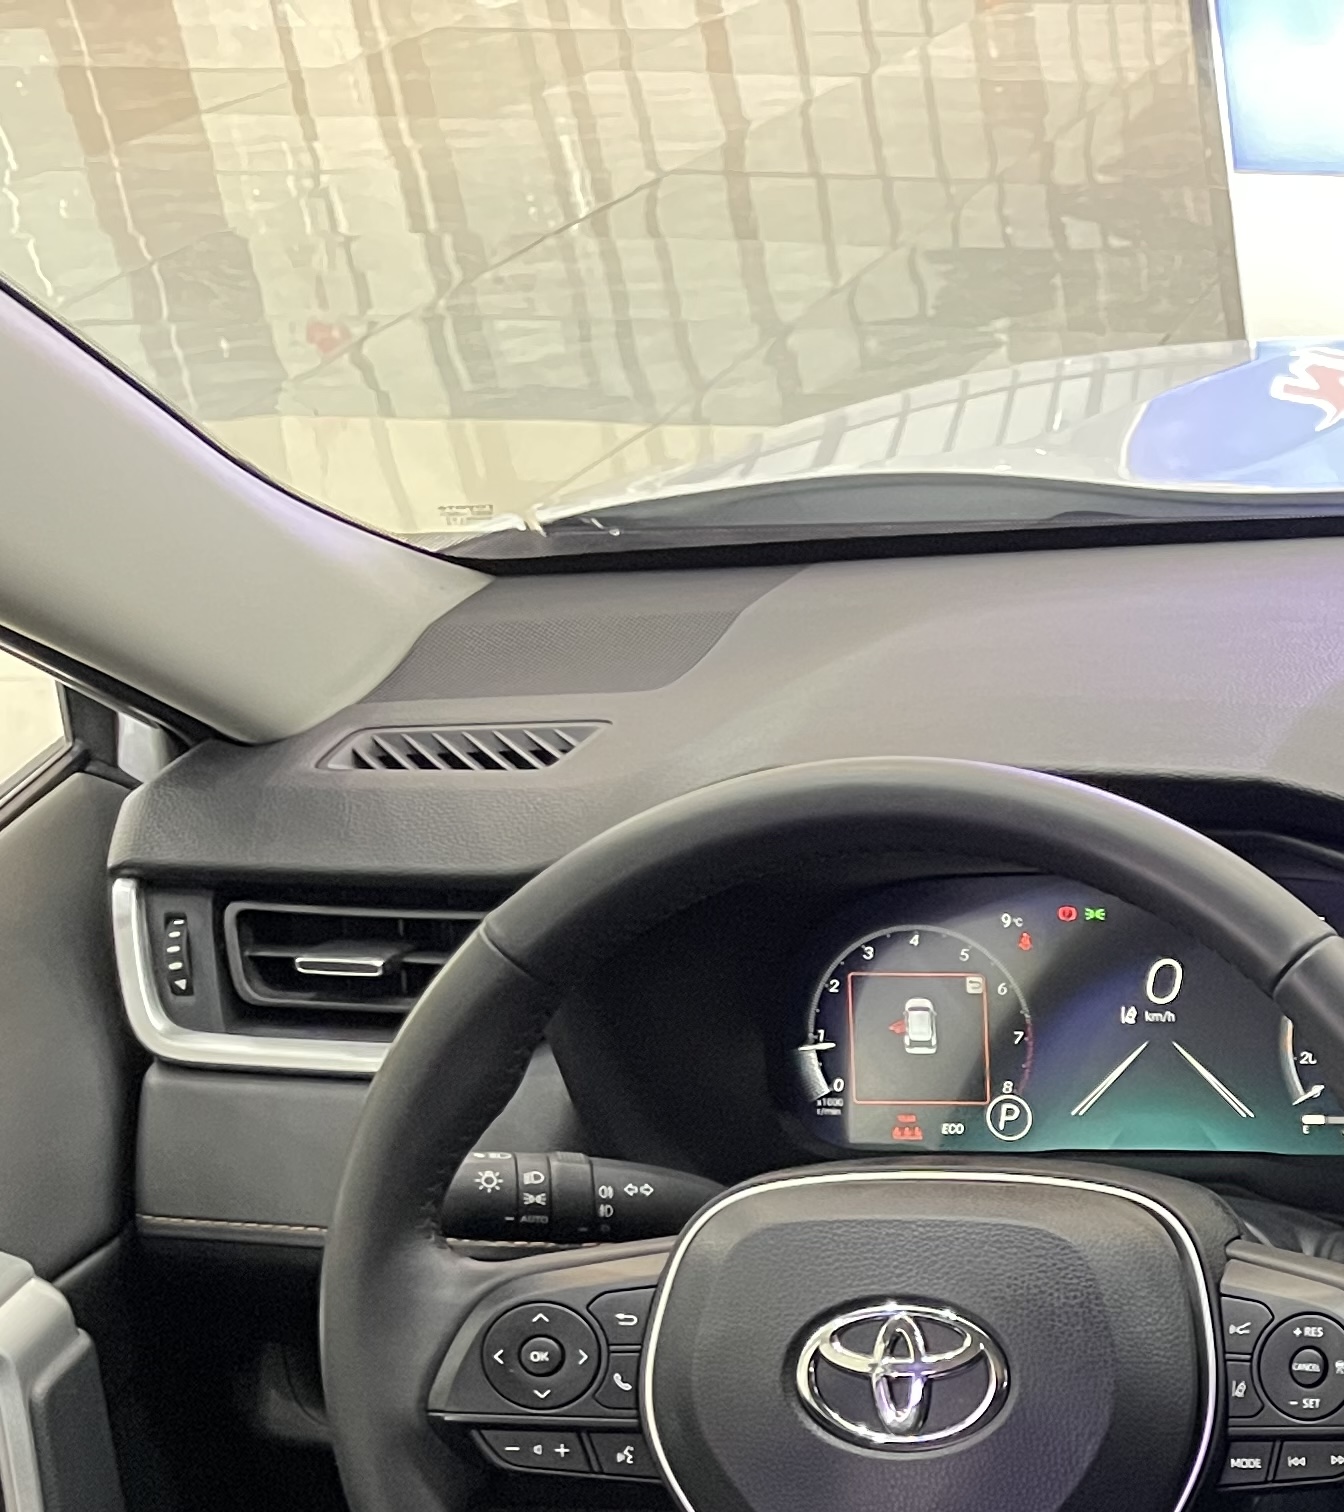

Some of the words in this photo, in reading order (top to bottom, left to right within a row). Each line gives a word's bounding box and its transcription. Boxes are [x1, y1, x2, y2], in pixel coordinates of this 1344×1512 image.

[909, 934, 920, 946] 4
[863, 946, 874, 959] 3
[960, 948, 969, 961] 5
[829, 979, 840, 993] 2
[1146, 958, 1183, 1005] 0
[998, 983, 1008, 995] 6
[1144, 1010, 1176, 1022] km/h
[817, 1030, 825, 1042] 1
[1013, 1031, 1025, 1044] 7
[833, 1078, 845, 1093] 0
[1002, 1081, 1014, 1093] 8
[998, 1102, 1021, 1131] P
[941, 1123, 965, 1135] ECO
[520, 1215, 549, 1224] AUTO
[530, 1350, 550, 1362] OK
[1230, 1458, 1262, 1469] MODE
